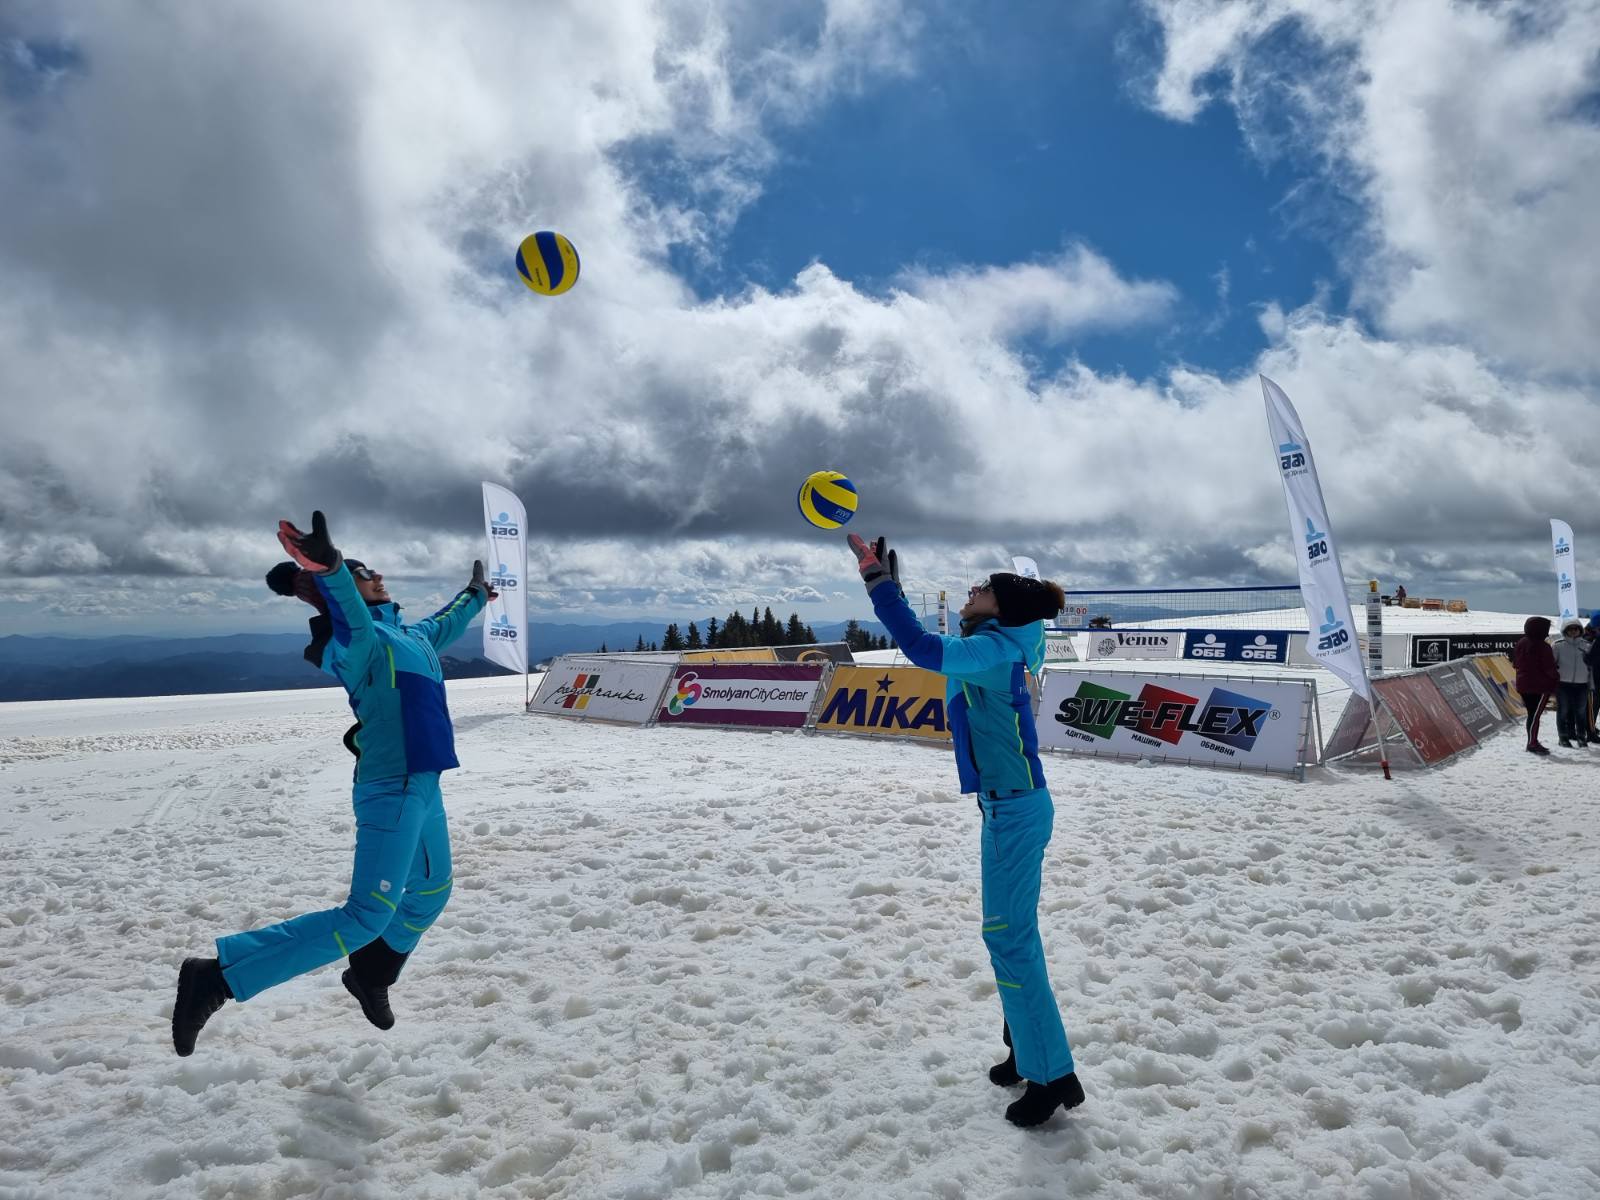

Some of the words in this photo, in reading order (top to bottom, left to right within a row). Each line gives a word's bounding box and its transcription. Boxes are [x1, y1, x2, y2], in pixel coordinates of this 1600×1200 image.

[1117, 633, 1168, 645] Venus
[1495, 641, 1517, 649] HOU
[1191, 648, 1226, 658] ОББ
[1241, 650, 1277, 660] ОББ
[702, 687, 808, 702] SmolyanCityCenter
[817, 687, 951, 732] MIKA
[1054, 697, 1267, 737] SWE-FLEX
[1065, 729, 1095, 743] АДИТИВИ
[1131, 733, 1162, 749] МАШИНИ
[1200, 740, 1236, 757] ОБВИВНИ
